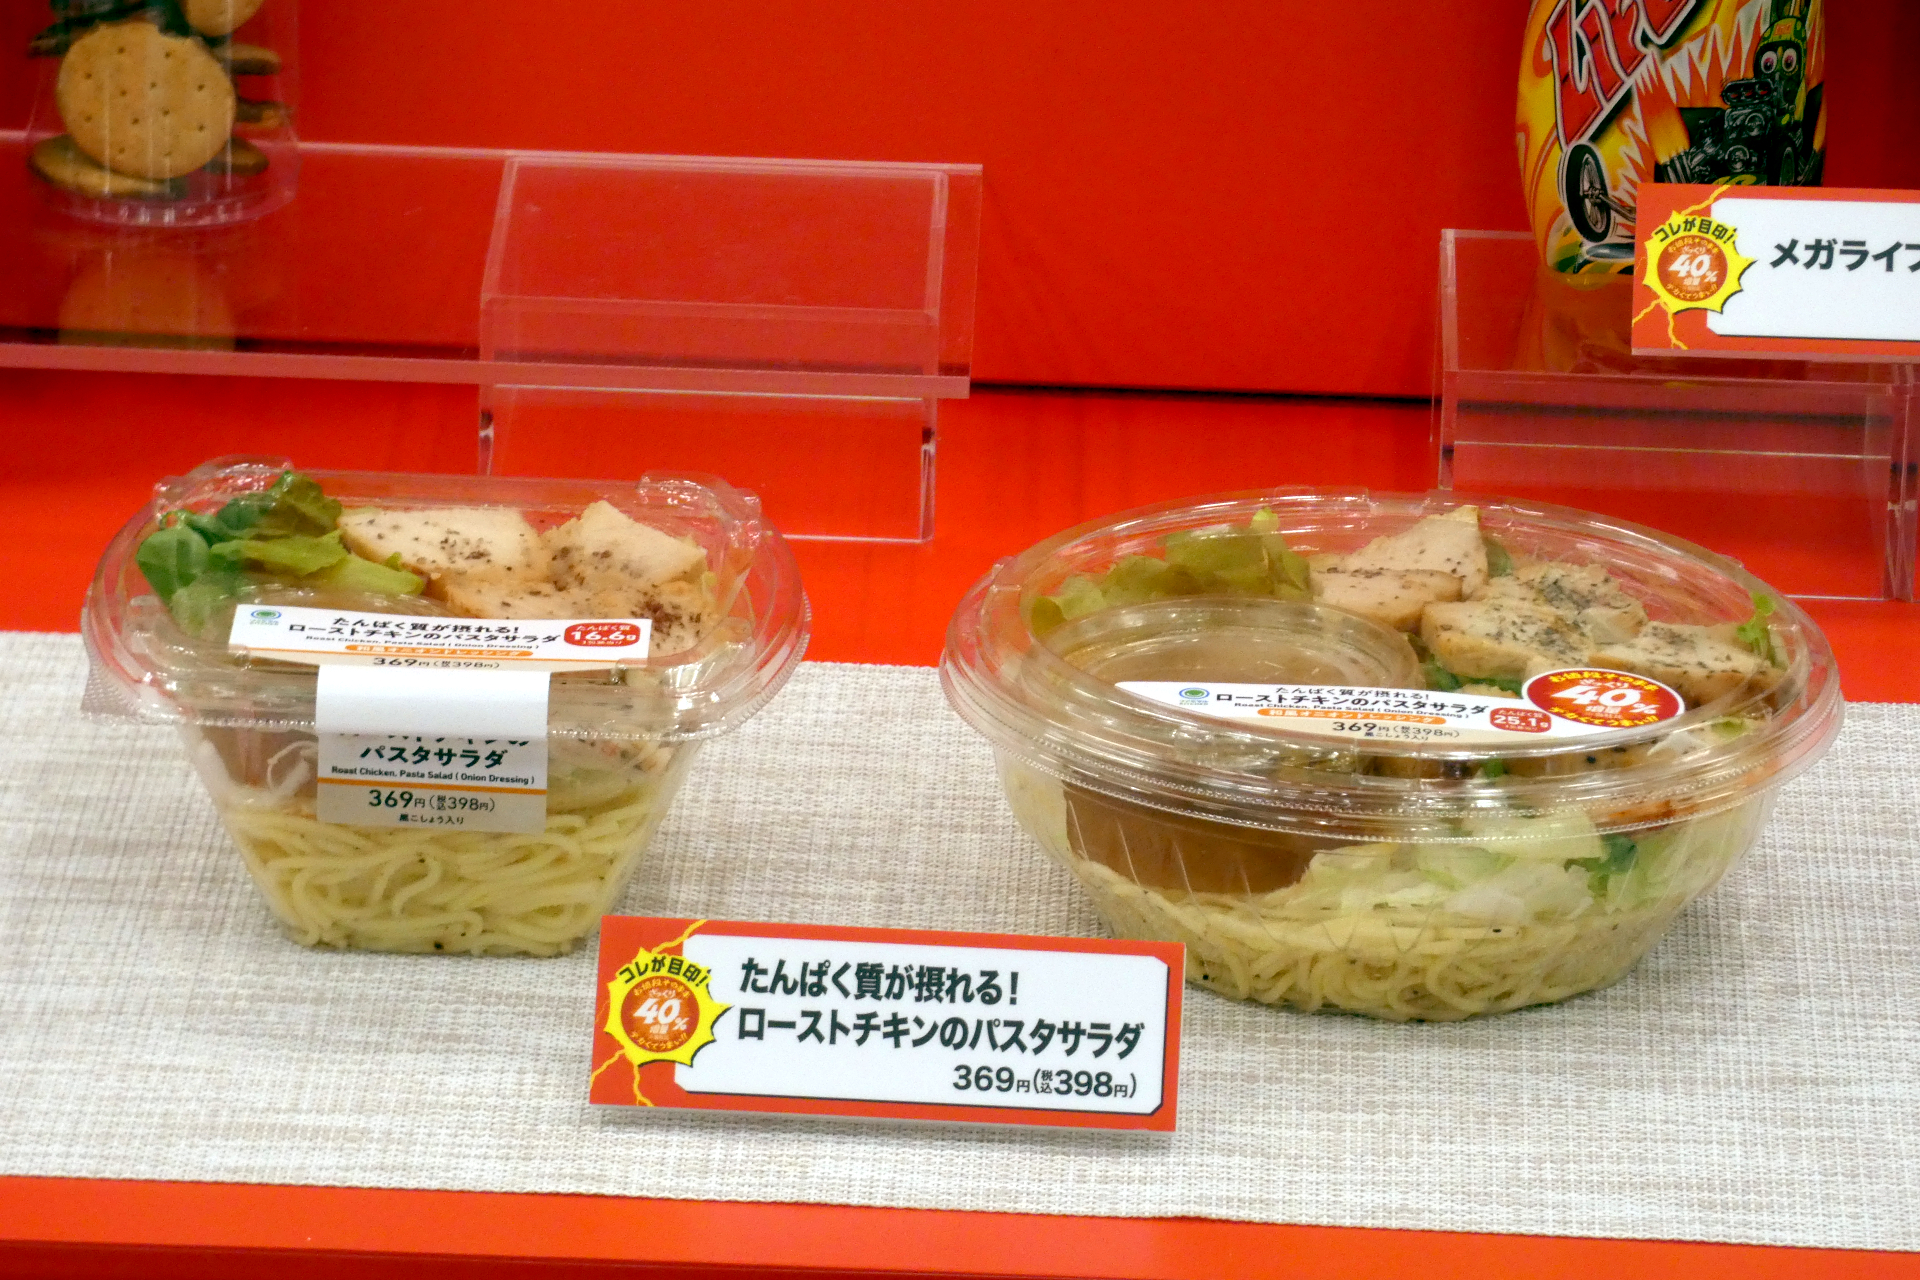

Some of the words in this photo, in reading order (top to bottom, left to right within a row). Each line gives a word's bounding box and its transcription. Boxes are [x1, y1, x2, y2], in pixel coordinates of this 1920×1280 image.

[1654, 217, 1737, 245] コレが目印!
[1668, 254, 1719, 283] 40%
[289, 624, 561, 643] ローストチキンのパスタサラダ
[333, 617, 519, 634] たんぱく質が摂れる!
[571, 631, 637, 641] 16.6g
[1216, 693, 1489, 715] ローストチキンのパスタサラダ
[1276, 687, 1429, 700] たんぱく質が摂れる!
[1551, 685, 1660, 714] 40%
[1493, 714, 1549, 728] 25.1g
[359, 745, 509, 769] パスタサラダ
[331, 766, 357, 775] Roast
[400, 770, 425, 779] Pasta
[427, 771, 453, 780] Salad
[398, 813, 464, 825] 黒こしょう入り
[618, 955, 711, 987] コレが目印!
[740, 957, 1020, 1008] たんぱく質が摂れる!
[633, 998, 690, 1031] 40%
[737, 1007, 1146, 1060] ローストチキンのパスタサラダ
